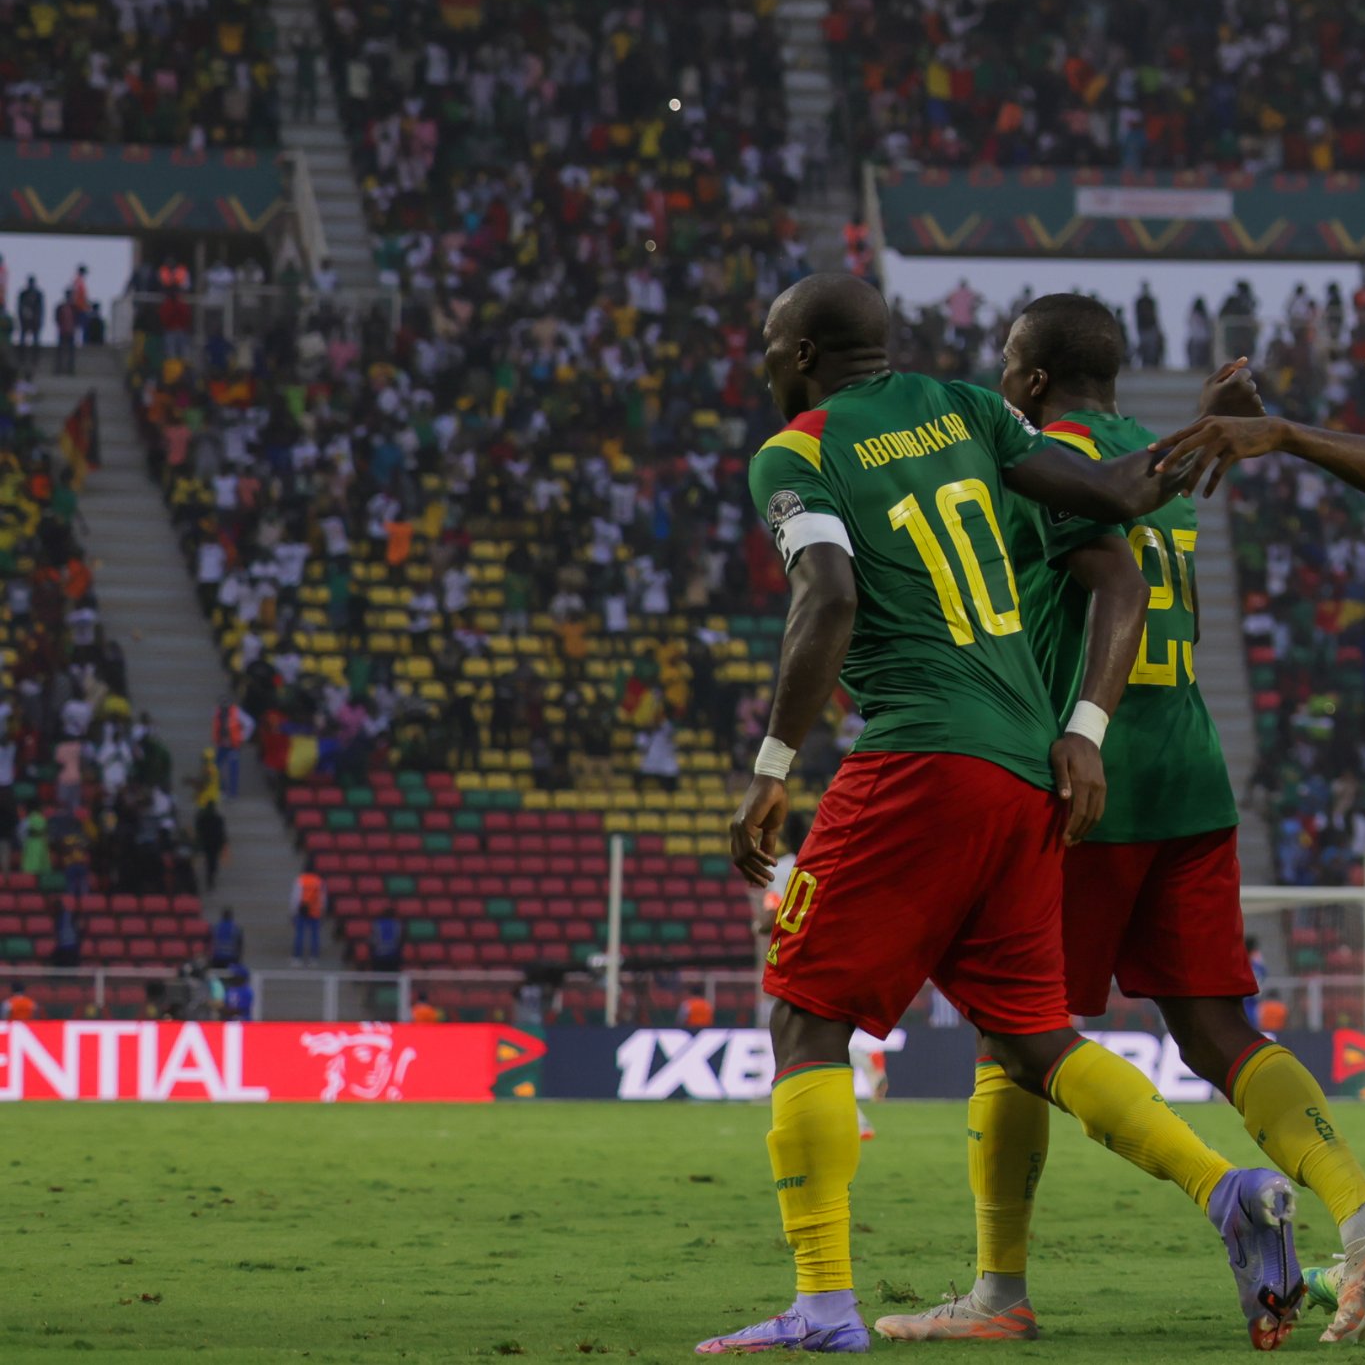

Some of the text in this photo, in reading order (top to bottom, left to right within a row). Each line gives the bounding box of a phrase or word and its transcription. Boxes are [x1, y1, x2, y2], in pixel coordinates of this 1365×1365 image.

[853, 412, 972, 470] ABOUBAKAR
[887, 478, 1023, 647] 10
[0, 1021, 270, 1101] NTIAL
